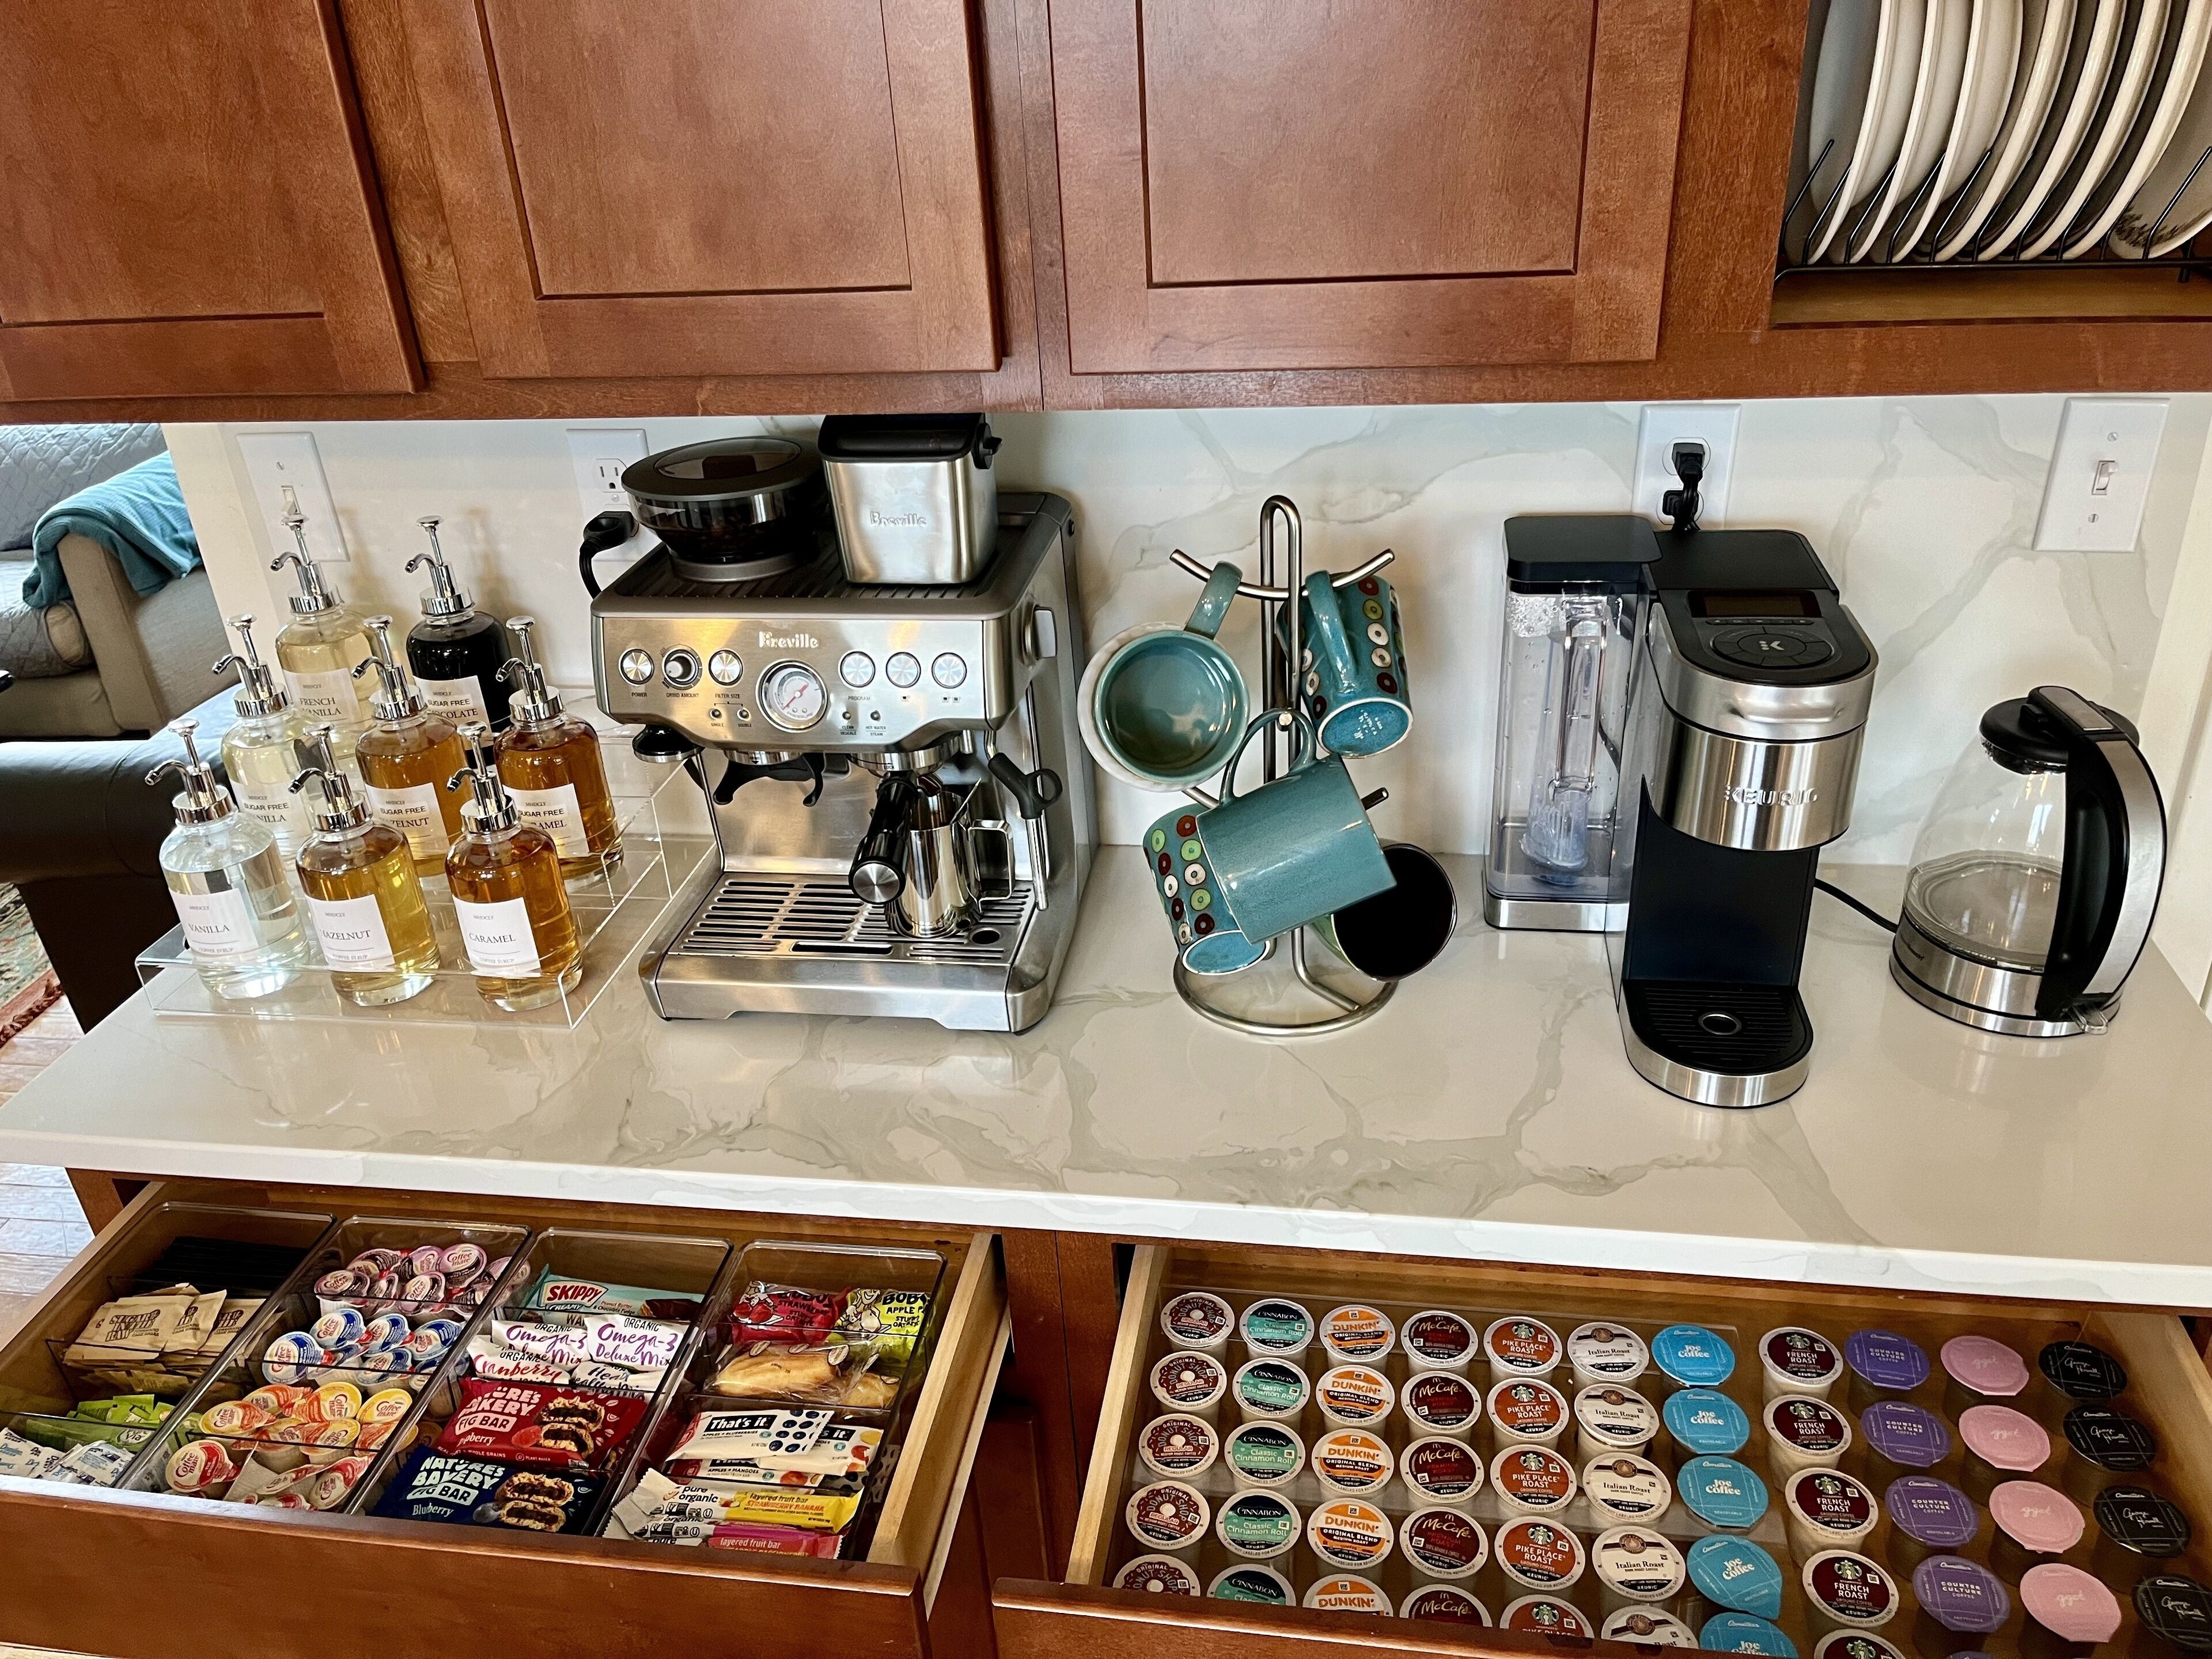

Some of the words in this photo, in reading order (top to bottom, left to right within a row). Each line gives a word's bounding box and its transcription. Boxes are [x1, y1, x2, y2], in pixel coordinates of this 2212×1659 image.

[870, 511, 926, 527] Breville
[759, 631, 819, 648] Breville
[300, 697, 336, 706] FRENCH
[1725, 785, 1817, 806] KEURIG
[267, 802, 289, 810] FREE
[405, 806, 426, 814] FREE
[188, 923, 230, 933] VANILLA
[320, 929, 371, 940] HAZELNUT
[469, 933, 516, 943] CARAMEL
[447, 1248, 472, 1262] Coffee
[452, 1258, 471, 1267] mate
[324, 1275, 347, 1288] Coffee
[547, 1284, 603, 1302] SKIPPY
[598, 1306, 620, 1314] Chocolate
[886, 1306, 916, 1315] APPLE
[1258, 1310, 1298, 1320] CINNABON
[624, 1317, 662, 1332] ORGANIC
[506, 1325, 588, 1349] Omega-3
[597, 1324, 679, 1351] Omega-3
[1249, 1326, 1286, 1335] Cinnamon
[1288, 1329, 1303, 1338] Roll
[1510, 1346, 1535, 1355] ROAST
[1520, 1342, 1543, 1351] PLACE
[500, 1351, 541, 1362] ORGANIC
[551, 1349, 582, 1366] Mix
[596, 1343, 639, 1363] Deluxe
[640, 1350, 671, 1368] Mix
[1678, 1350, 1710, 1358] Coffee
[474, 1354, 564, 1384] Cranberry
[1170, 1363, 1185, 1385] DONUT
[1188, 1364, 1208, 1380] SHOP
[1254, 1369, 1296, 1383] CINNABON
[1243, 1385, 1280, 1398] Cinnamon
[1281, 1393, 1297, 1402] Roll
[1257, 1384, 1283, 1393] Classic
[335, 1393, 348, 1418] Coffee
[376, 1401, 402, 1412] Coffee
[214, 1408, 229, 1427] Coffee
[1620, 1411, 1641, 1419] Roast
[1698, 1410, 1716, 1418] Joe
[458, 1415, 479, 1431] FIG
[479, 1416, 510, 1429] BAR
[711, 1417, 751, 1430] That's
[753, 1416, 768, 1427] it
[1690, 1416, 1724, 1426] Coffee
[1158, 1426, 1178, 1448] DONUT
[1181, 1427, 1199, 1445] SHOP
[1243, 1435, 1287, 1445] CINNABON
[176, 1452, 195, 1478] Coffee
[188, 1455, 200, 1474] mate
[1235, 1455, 1275, 1463] Cinnamon
[1277, 1457, 1293, 1465] Roll
[412, 1470, 500, 1490] BAKERY
[1522, 1480, 1548, 1488] ROAST
[1533, 1475, 1557, 1483] PLACE
[411, 1486, 437, 1496] FIG
[438, 1485, 472, 1502] BAR
[682, 1486, 709, 1494] pure
[1603, 1482, 1628, 1490] Italian
[1629, 1484, 1651, 1494] Roast
[1705, 1484, 1741, 1495] Coffee
[679, 1492, 718, 1503] organic
[750, 1493, 778, 1501] layered
[1817, 1498, 1850, 1506] FRENCH
[412, 1502, 454, 1517] Blueberry
[795, 1504, 825, 1512] BANANA
[1146, 1495, 1174, 1512] DONUT
[1176, 1498, 1190, 1521] SHOP
[1237, 1506, 1282, 1516] CINNABON
[1821, 1504, 1850, 1513] ROAST
[1227, 1526, 1270, 1536] Cinnamon
[1271, 1528, 1288, 1537] Roll
[1323, 1528, 1355, 1539] ORIGINAL
[720, 1537, 749, 1547] layered
[749, 1539, 767, 1548] fruit
[768, 1540, 781, 1549] bar
[1516, 1544, 1534, 1554] PIKE
[1524, 1554, 1552, 1566] ROAST
[1724, 1558, 1743, 1571] Joe
[1722, 1563, 1755, 1580] Coffee
[1232, 1577, 1278, 1597] CINNABON
[1834, 1582, 1869, 1594] FRENCH
[1941, 1581, 1980, 1590] COUNTER
[1942, 1586, 1982, 1596] CULTURE
[1838, 1589, 1868, 1600] ROAST
